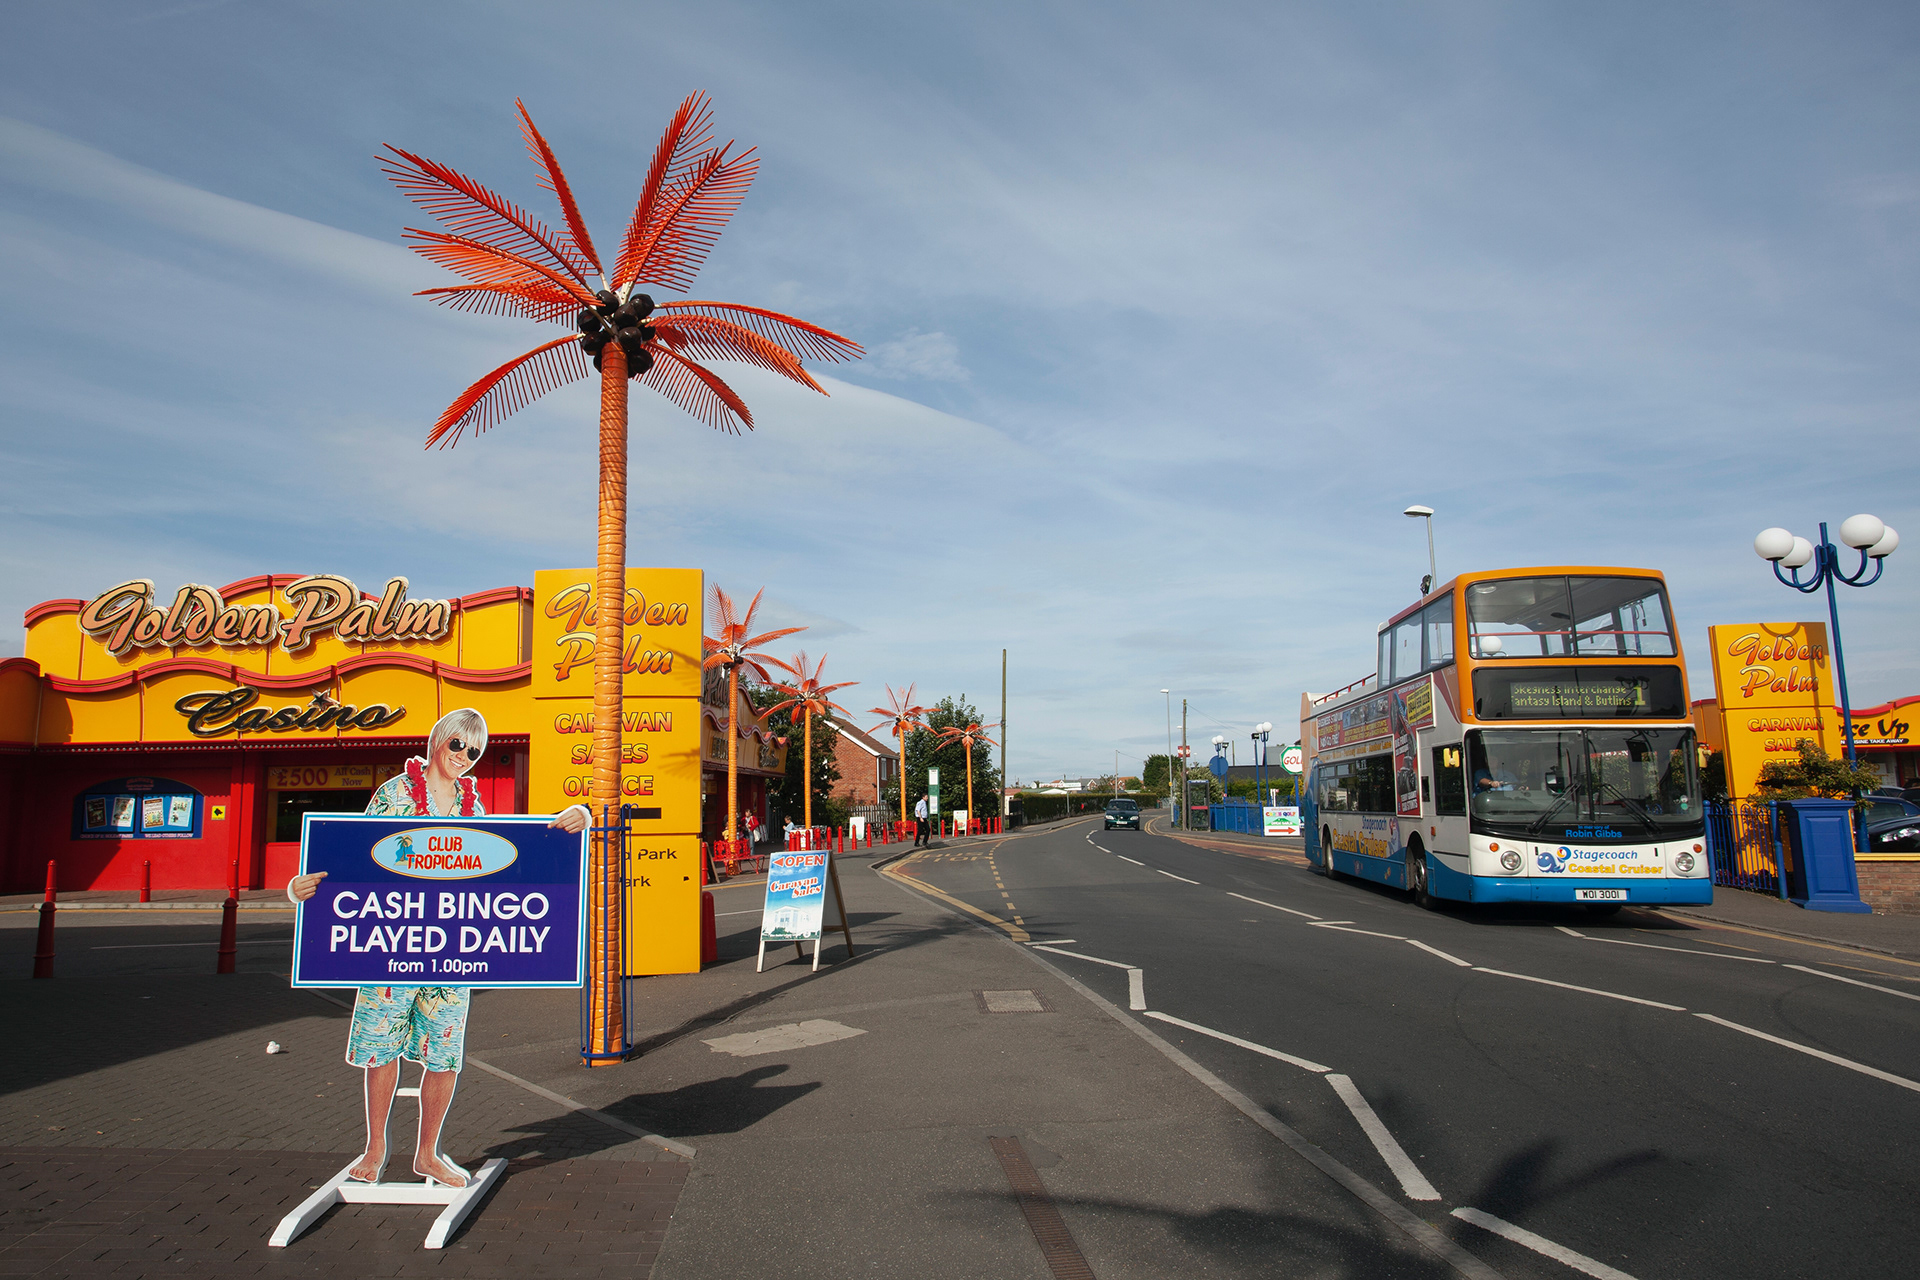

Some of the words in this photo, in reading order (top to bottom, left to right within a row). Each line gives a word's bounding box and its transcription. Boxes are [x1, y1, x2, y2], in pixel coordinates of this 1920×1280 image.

[77, 579, 279, 657] Golden
[277, 576, 452, 653] Palm
[545, 583, 688, 632] Goden
[553, 631, 673, 681] Plm
[1728, 632, 1823, 666] Golden
[1740, 665, 1818, 698] Palm
[1511, 696, 1550, 706] antasy
[1552, 696, 1582, 706] Island
[1584, 696, 1593, 705] &
[1596, 696, 1632, 706] Butlins
[1634, 686, 1646, 706] 1
[174, 686, 406, 738] Casino
[555, 712, 672, 734] CAVAN
[1747, 717, 1824, 732] CARAVAN
[1877, 718, 1909, 739] Up
[571, 743, 648, 765] SES
[1283, 756, 1302, 765] GOL
[277, 767, 328, 787] £500
[334, 767, 347, 776] All
[348, 767, 371, 776] Cash
[342, 778, 362, 786] Now
[563, 775, 653, 797] OFCE
[1362, 815, 1387, 834] Stagecoach
[1565, 829, 1593, 838] Robin
[1595, 829, 1623, 838] Gibbs
[428, 836, 463, 852] CLUB
[1333, 828, 1358, 853] Coastal
[1358, 831, 1388, 858] Cruiser
[406, 854, 482, 870] TROPICANA
[638, 849, 677, 860] Park
[785, 854, 825, 867] OPEN
[1573, 849, 1638, 862] Stagecoach
[1568, 863, 1615, 874] Coastal
[1619, 864, 1663, 874] Cruiser
[621, 876, 652, 887] ark
[770, 877, 818, 893] Caravan
[792, 884, 822, 898] Sales
[333, 891, 425, 919] CASH
[438, 891, 549, 920] BINGO
[330, 926, 447, 953] PLAYED
[460, 926, 551, 953] DAILY
[388, 958, 424, 973] from
[431, 959, 488, 975] 1.00pm
